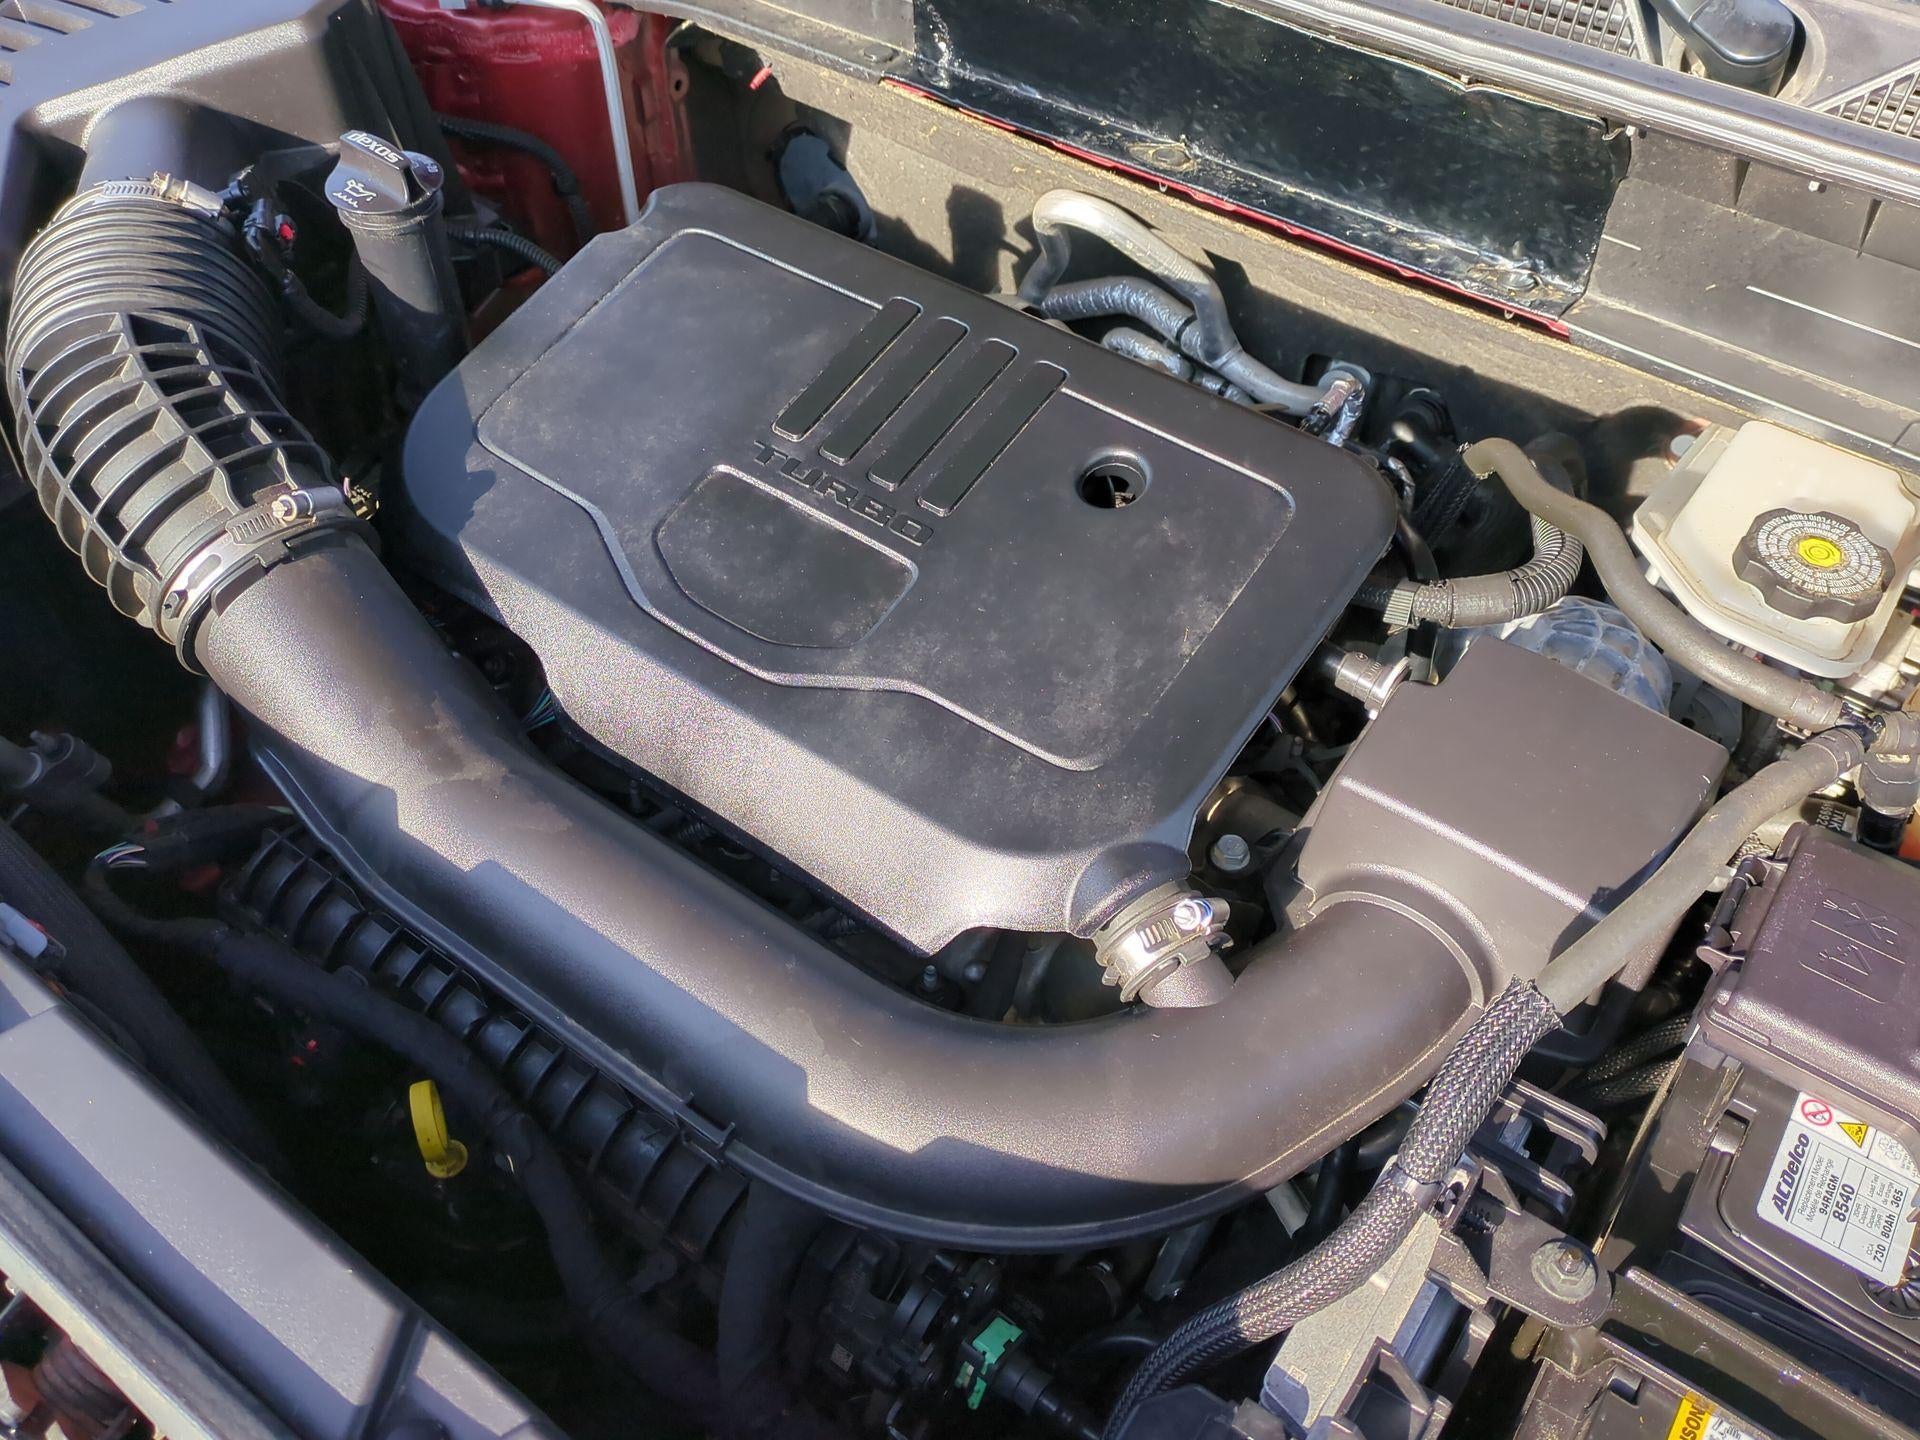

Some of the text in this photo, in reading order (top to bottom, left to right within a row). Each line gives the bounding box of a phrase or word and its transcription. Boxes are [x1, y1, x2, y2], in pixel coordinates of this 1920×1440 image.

[348, 132, 405, 163] dexos
[753, 440, 934, 547] TURBO
[1789, 576, 1802, 585] LA
[1802, 581, 1828, 593] AVANT
[1815, 578, 1826, 586] DE
[1771, 1132, 1810, 1214] ACDelco
[1797, 1155, 1823, 1215] Replacement Model
[1816, 1157, 1834, 1189] Rechange
[1814, 1187, 1822, 1198] de
[1819, 1173, 1839, 1215] 94RAGM
[1831, 1182, 1855, 1221] 8540
[1890, 1188, 1903, 1207] 365
[1881, 1212, 1896, 1238] 80Ah
[1872, 1243, 1886, 1263] 730
